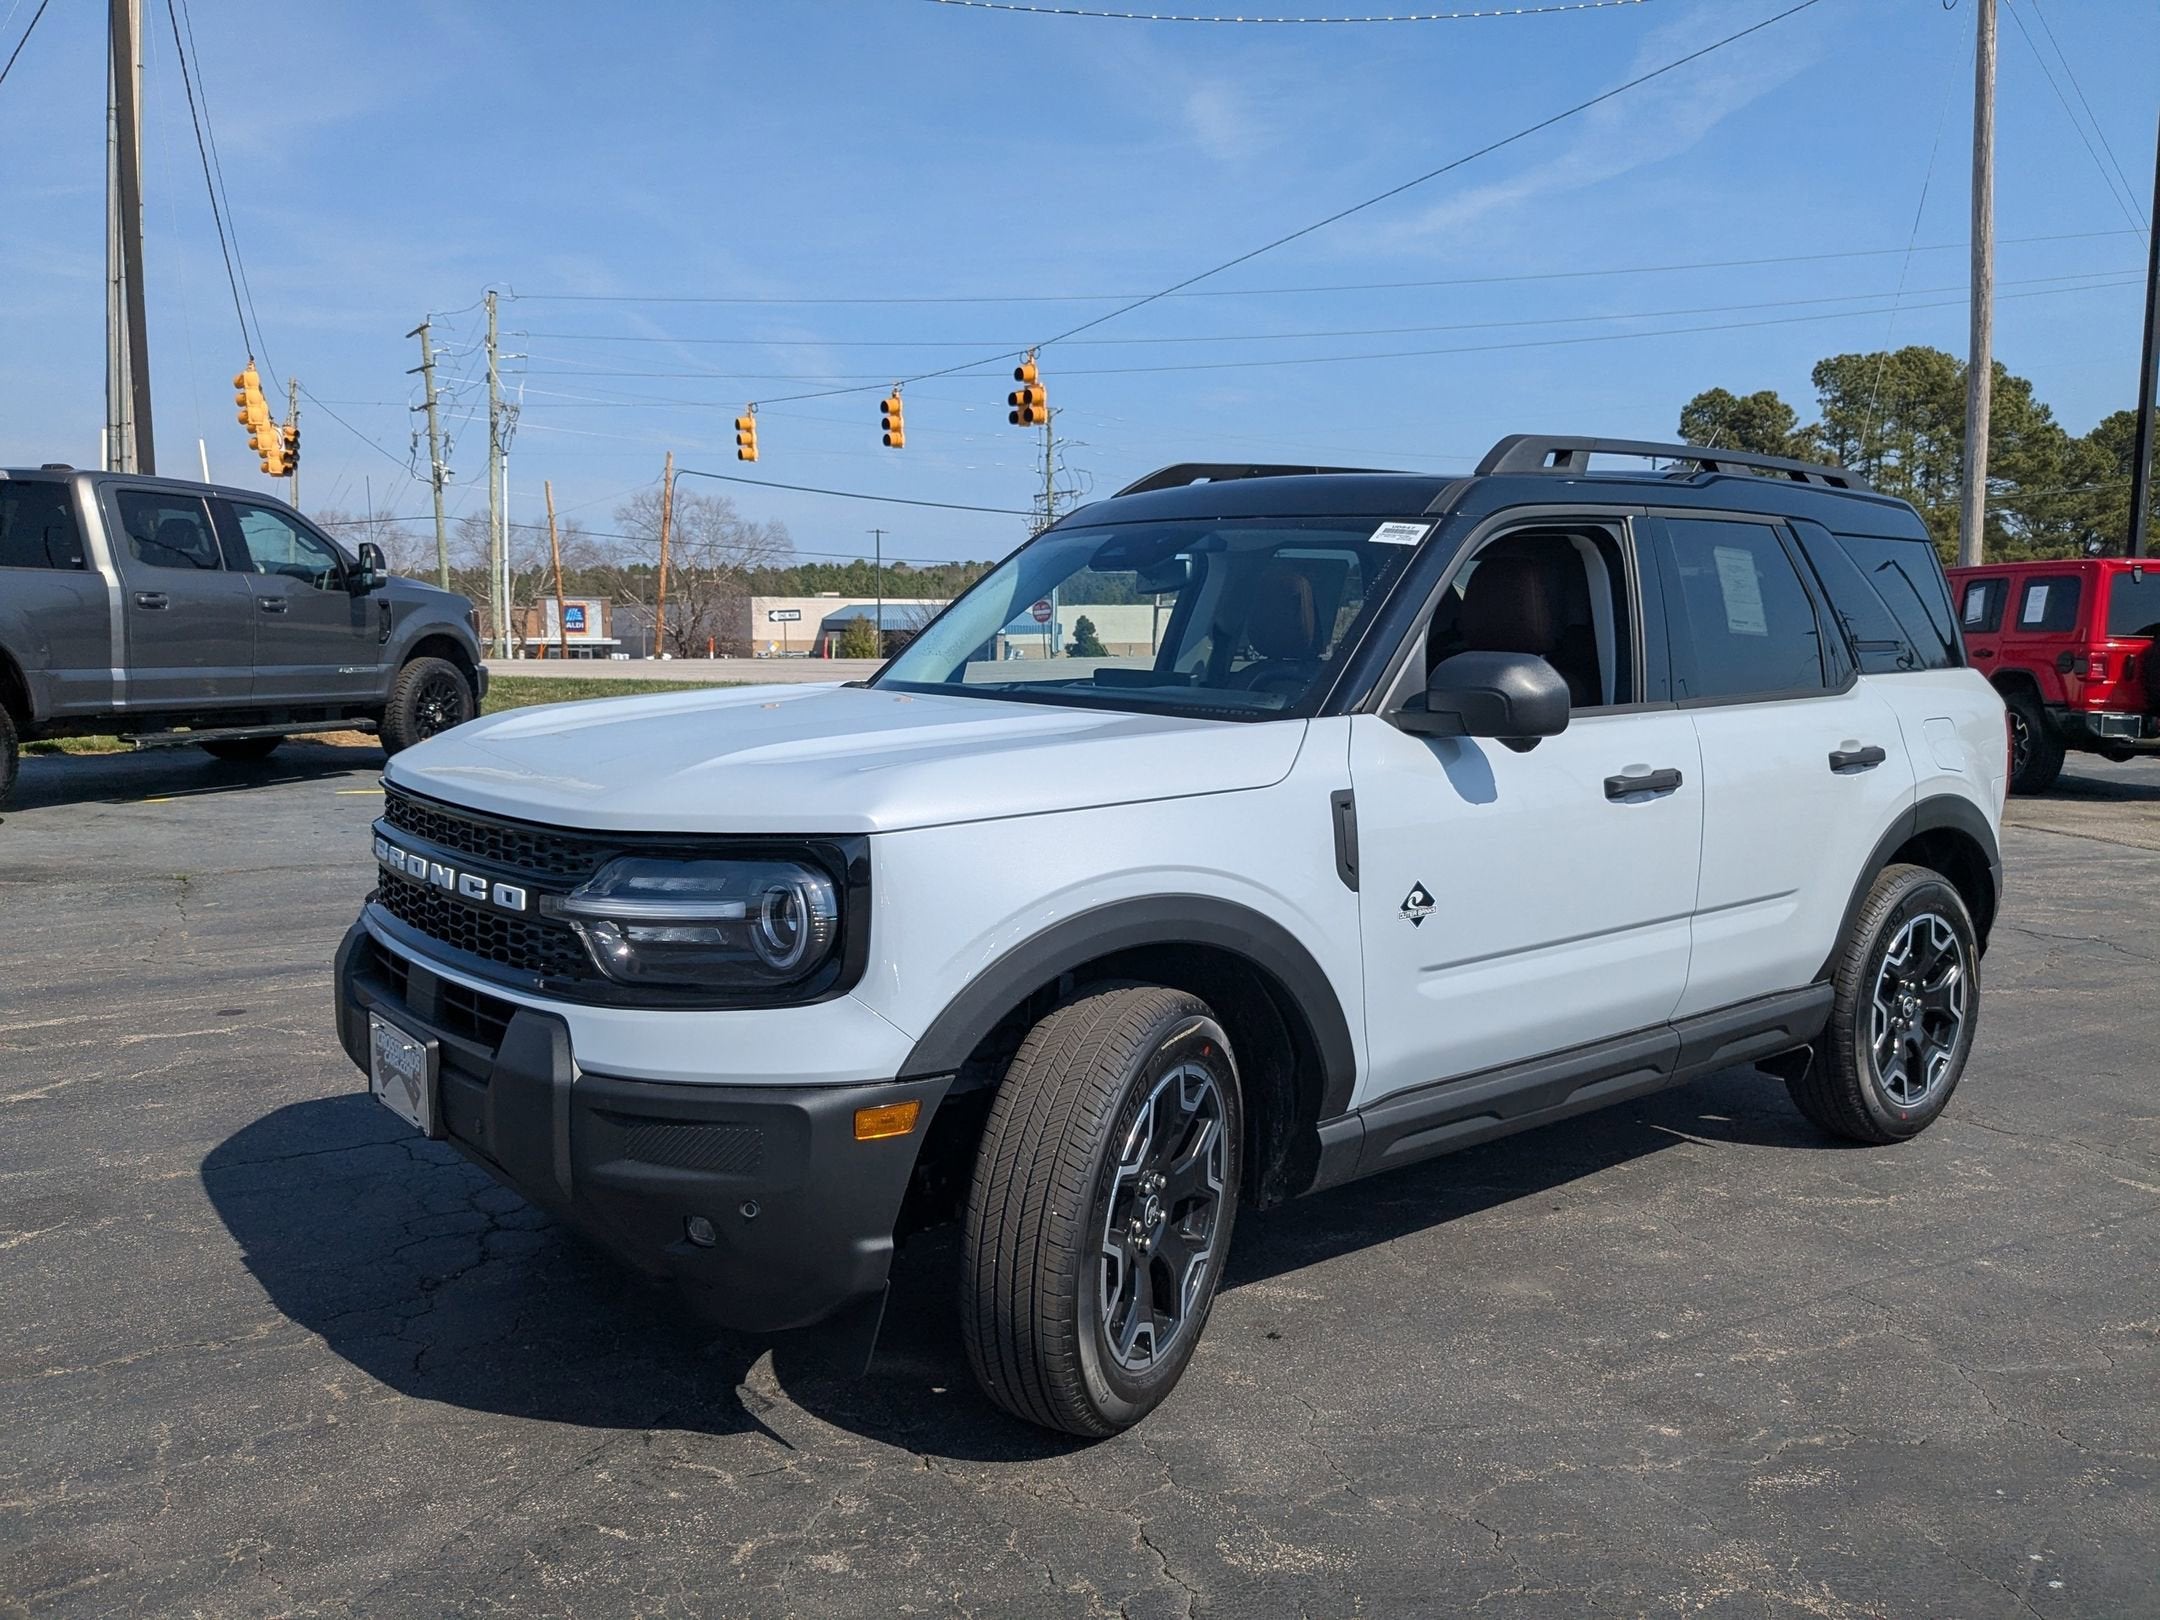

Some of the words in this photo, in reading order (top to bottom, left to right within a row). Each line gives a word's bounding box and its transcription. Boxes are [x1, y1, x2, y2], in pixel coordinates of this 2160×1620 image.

[375, 837, 526, 911] BRONCO
[1399, 909, 1418, 920] OUTER
[1418, 906, 1436, 916] BANKS
